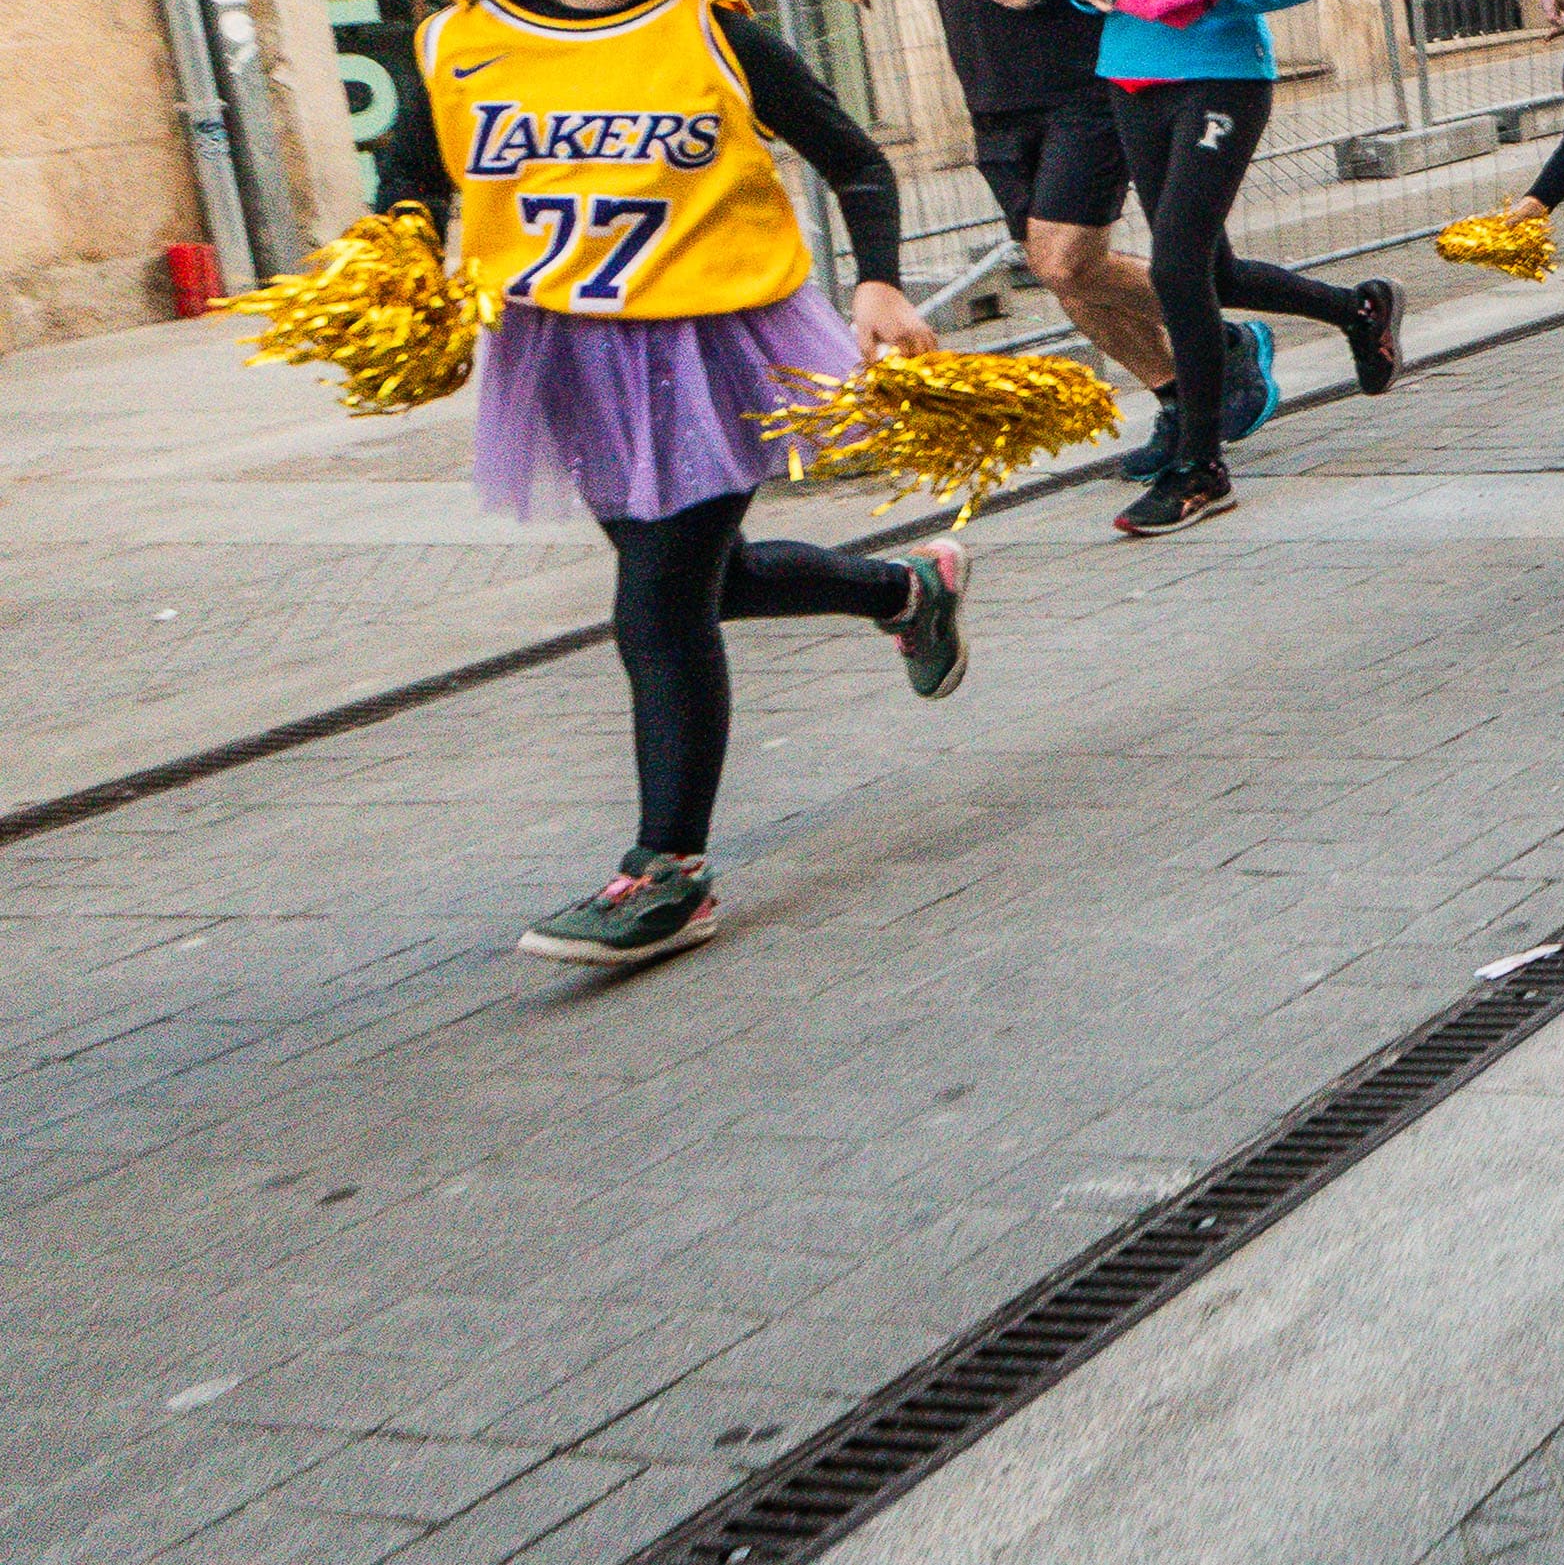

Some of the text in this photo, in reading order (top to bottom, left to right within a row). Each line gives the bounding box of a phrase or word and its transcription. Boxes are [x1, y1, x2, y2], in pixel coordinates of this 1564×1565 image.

[466, 101, 722, 180] LAKERS
[1198, 110, 1235, 150] P
[503, 192, 673, 314] 77
